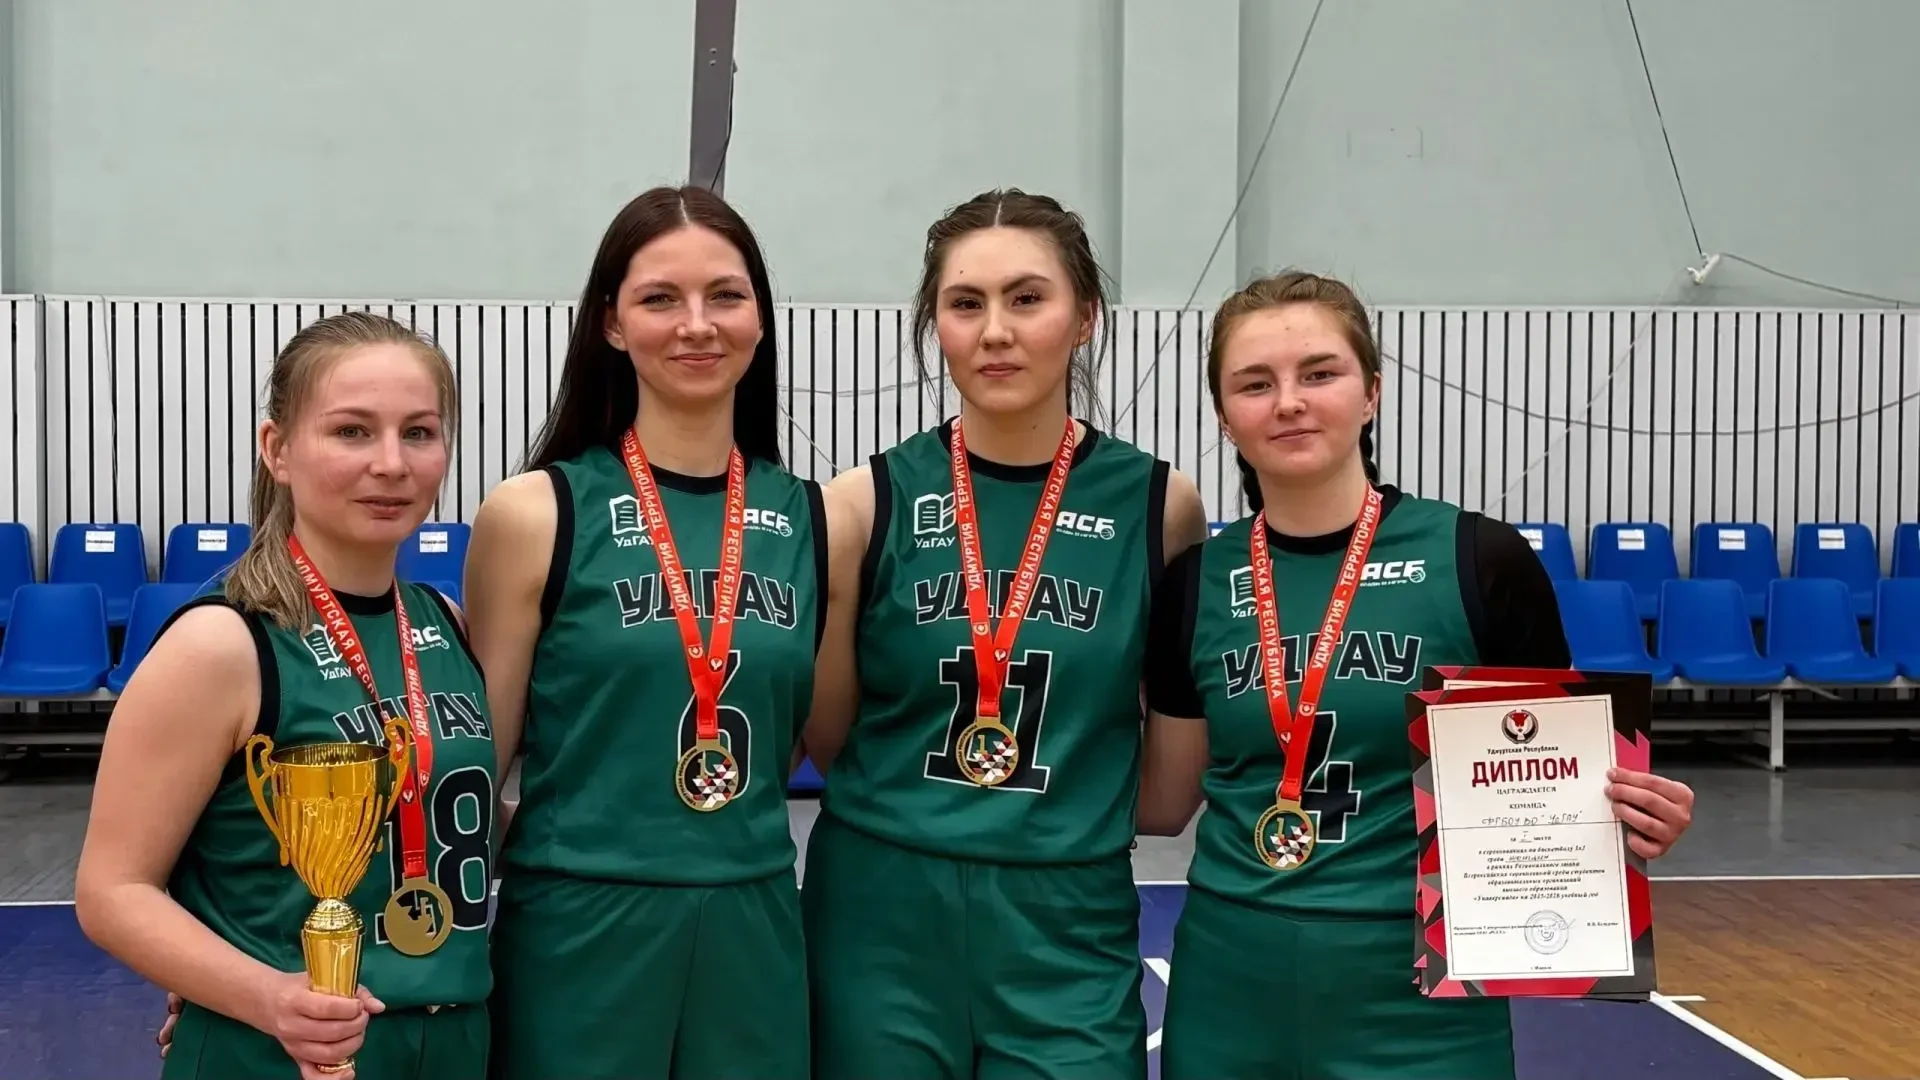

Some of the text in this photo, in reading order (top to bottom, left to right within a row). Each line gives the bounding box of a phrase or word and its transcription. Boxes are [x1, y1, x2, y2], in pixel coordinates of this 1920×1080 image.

[629, 453, 665, 531] ТЕРРИТОРИЯ
[1007, 431, 1075, 618] УДМУРТСКАЯ РЕСПУБЛИКА
[717, 447, 743, 624] МУРТСКАЯ РЕСПУБЛИКА
[914, 537, 956, 549] УдГАУ
[962, 522, 981, 591] УДМУРТИЯ
[659, 542, 691, 611] УДМУРТИЯ
[1231, 607, 1259, 618] УдГ
[1252, 517, 1283, 699] МУРТСКАЯ РЕСПУБЛИКА
[1312, 600, 1346, 669] УДМУРТИЯ
[1340, 505, 1377, 586] ТЕРРИТОРИЯ
[924, 646, 1053, 793] 11
[1471, 757, 1579, 788] ДИПЛОМ
[1509, 802, 1546, 810] КОМАНДА
